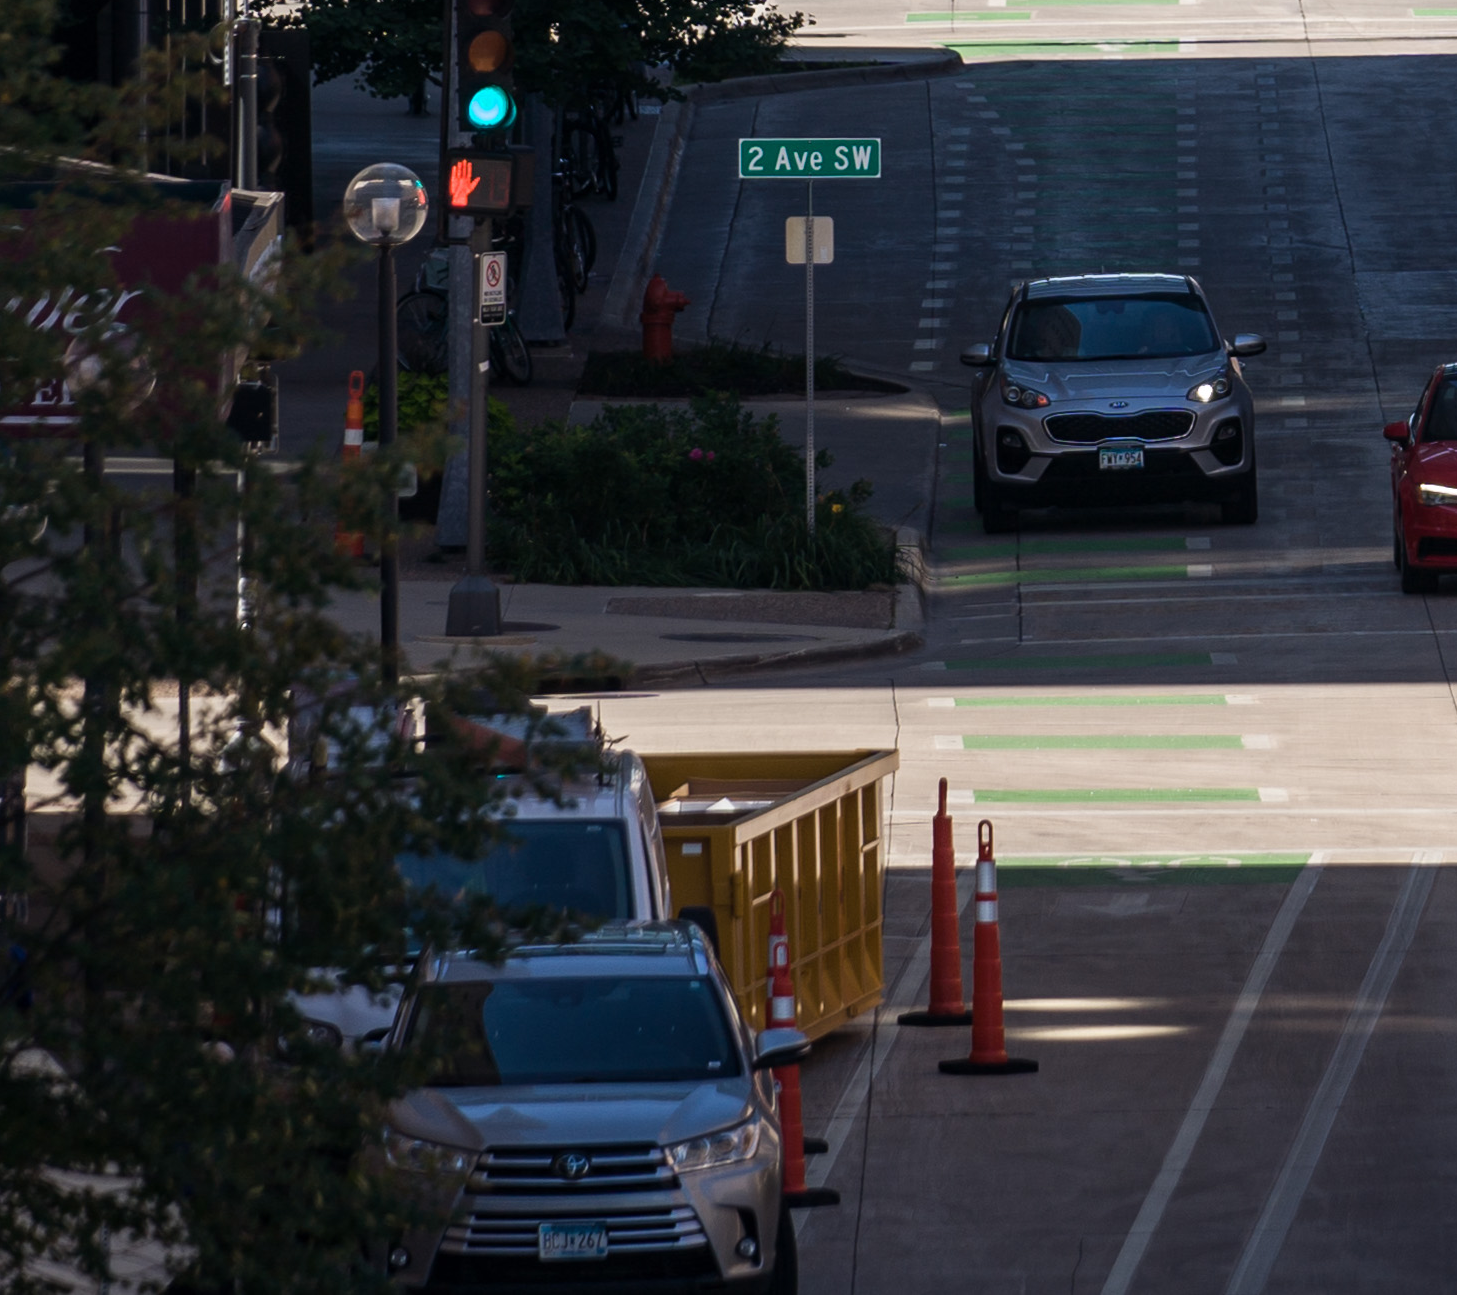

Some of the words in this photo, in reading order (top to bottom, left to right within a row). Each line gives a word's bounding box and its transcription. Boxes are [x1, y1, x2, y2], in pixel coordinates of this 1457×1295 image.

[748, 146, 764, 171] 2
[775, 146, 823, 171] Ave
[834, 145, 872, 171] SW
